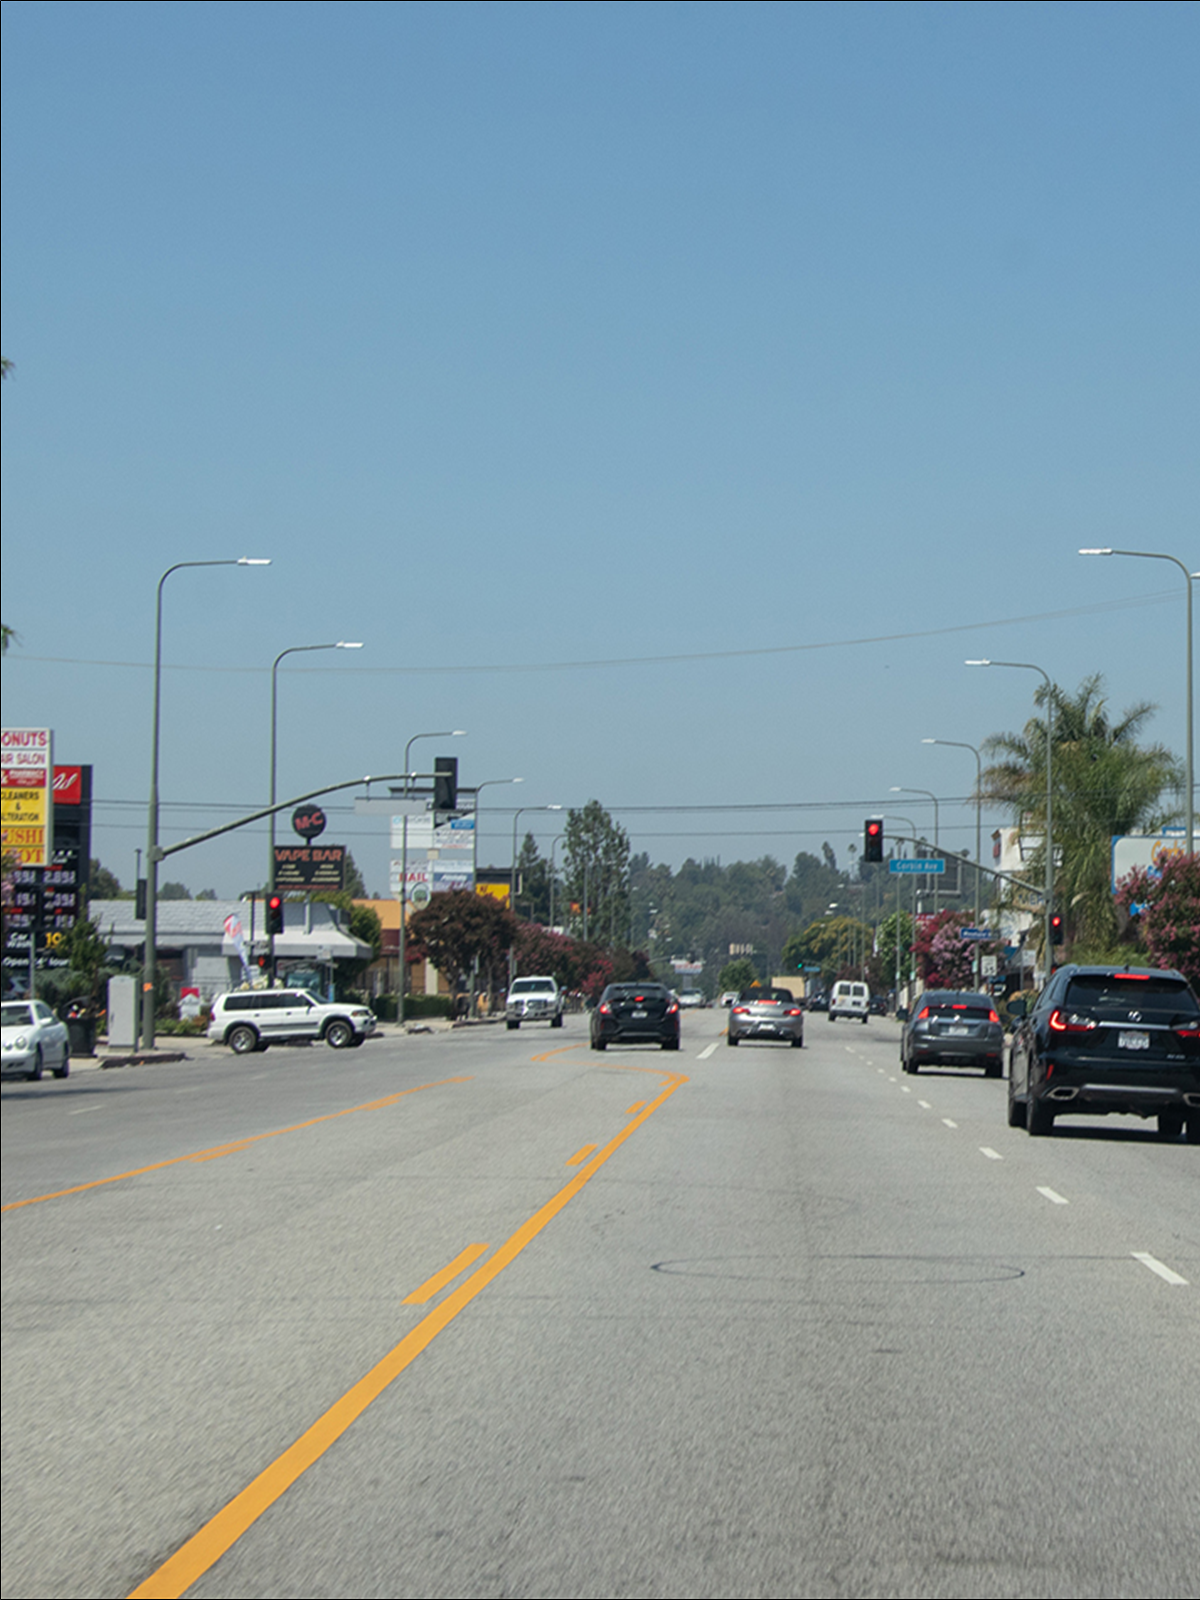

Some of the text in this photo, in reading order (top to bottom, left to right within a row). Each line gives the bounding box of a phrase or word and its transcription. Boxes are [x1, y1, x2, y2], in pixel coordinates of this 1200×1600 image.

[2, 731, 47, 747] ONUTS
[274, 849, 342, 862] VAPE BAR
[896, 861, 938, 870] Corbin Ave
